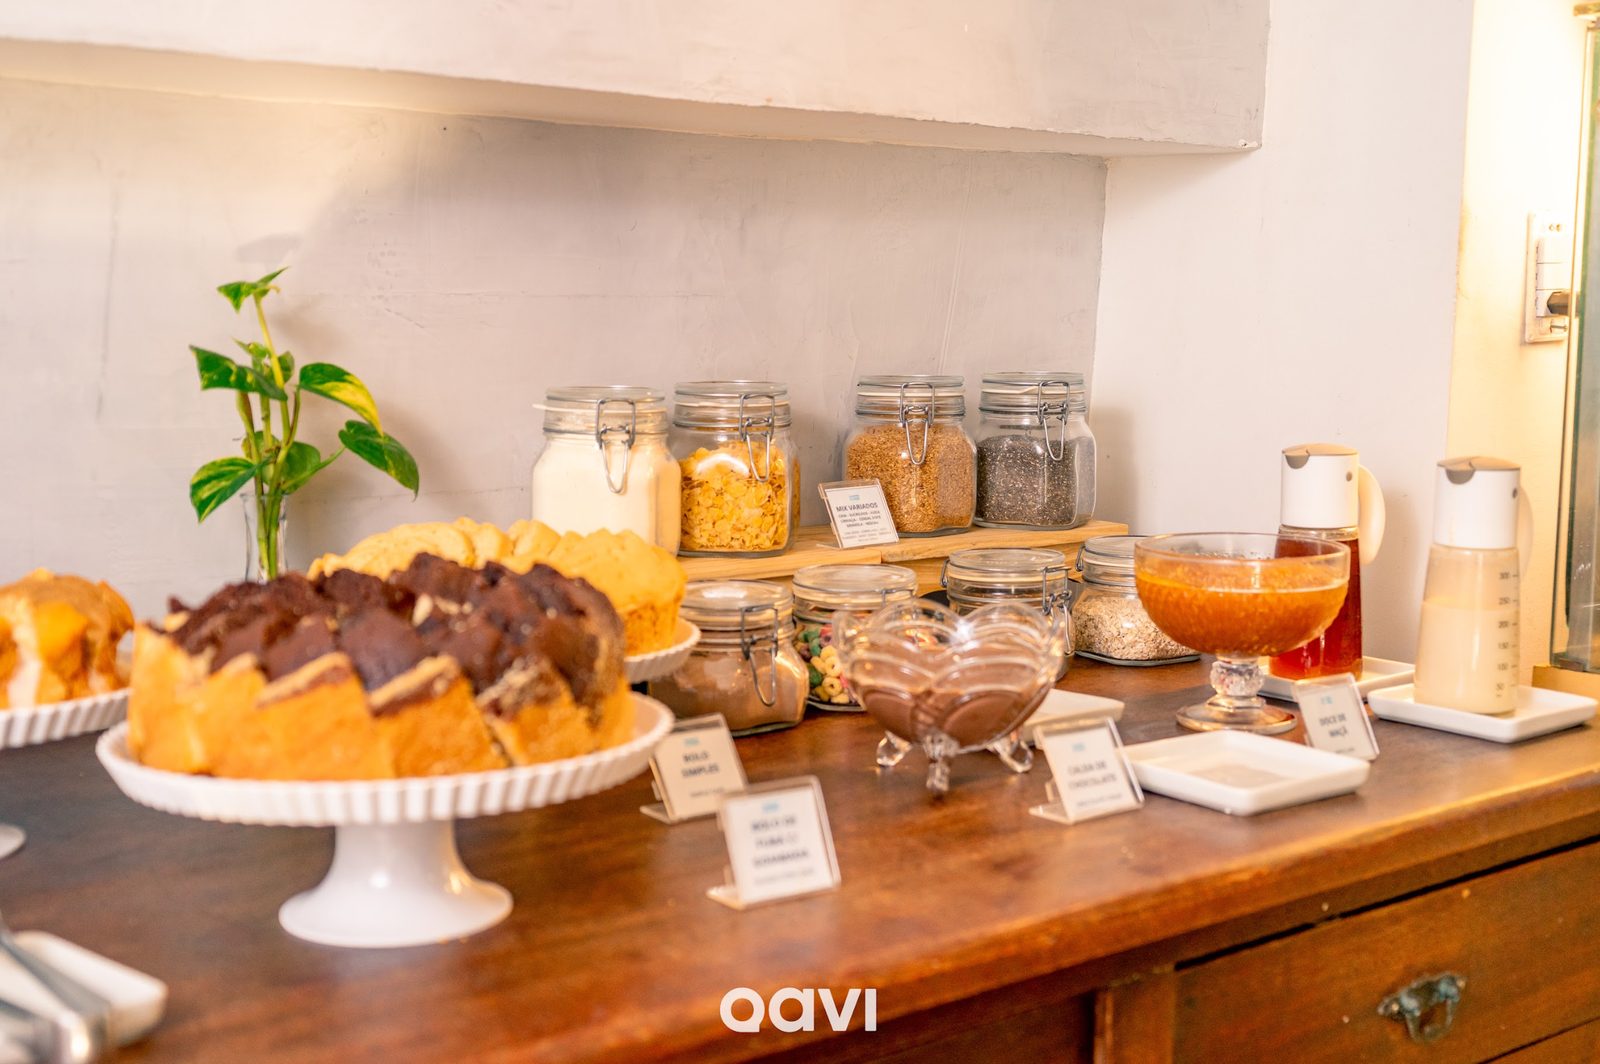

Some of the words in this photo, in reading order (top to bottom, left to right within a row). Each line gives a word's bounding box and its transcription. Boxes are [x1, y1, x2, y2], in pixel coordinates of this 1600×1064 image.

[836, 504, 848, 512] MIX
[848, 502, 878, 511] VARIADOS
[1499, 597, 1510, 605] 250
[683, 750, 709, 763] BOLO
